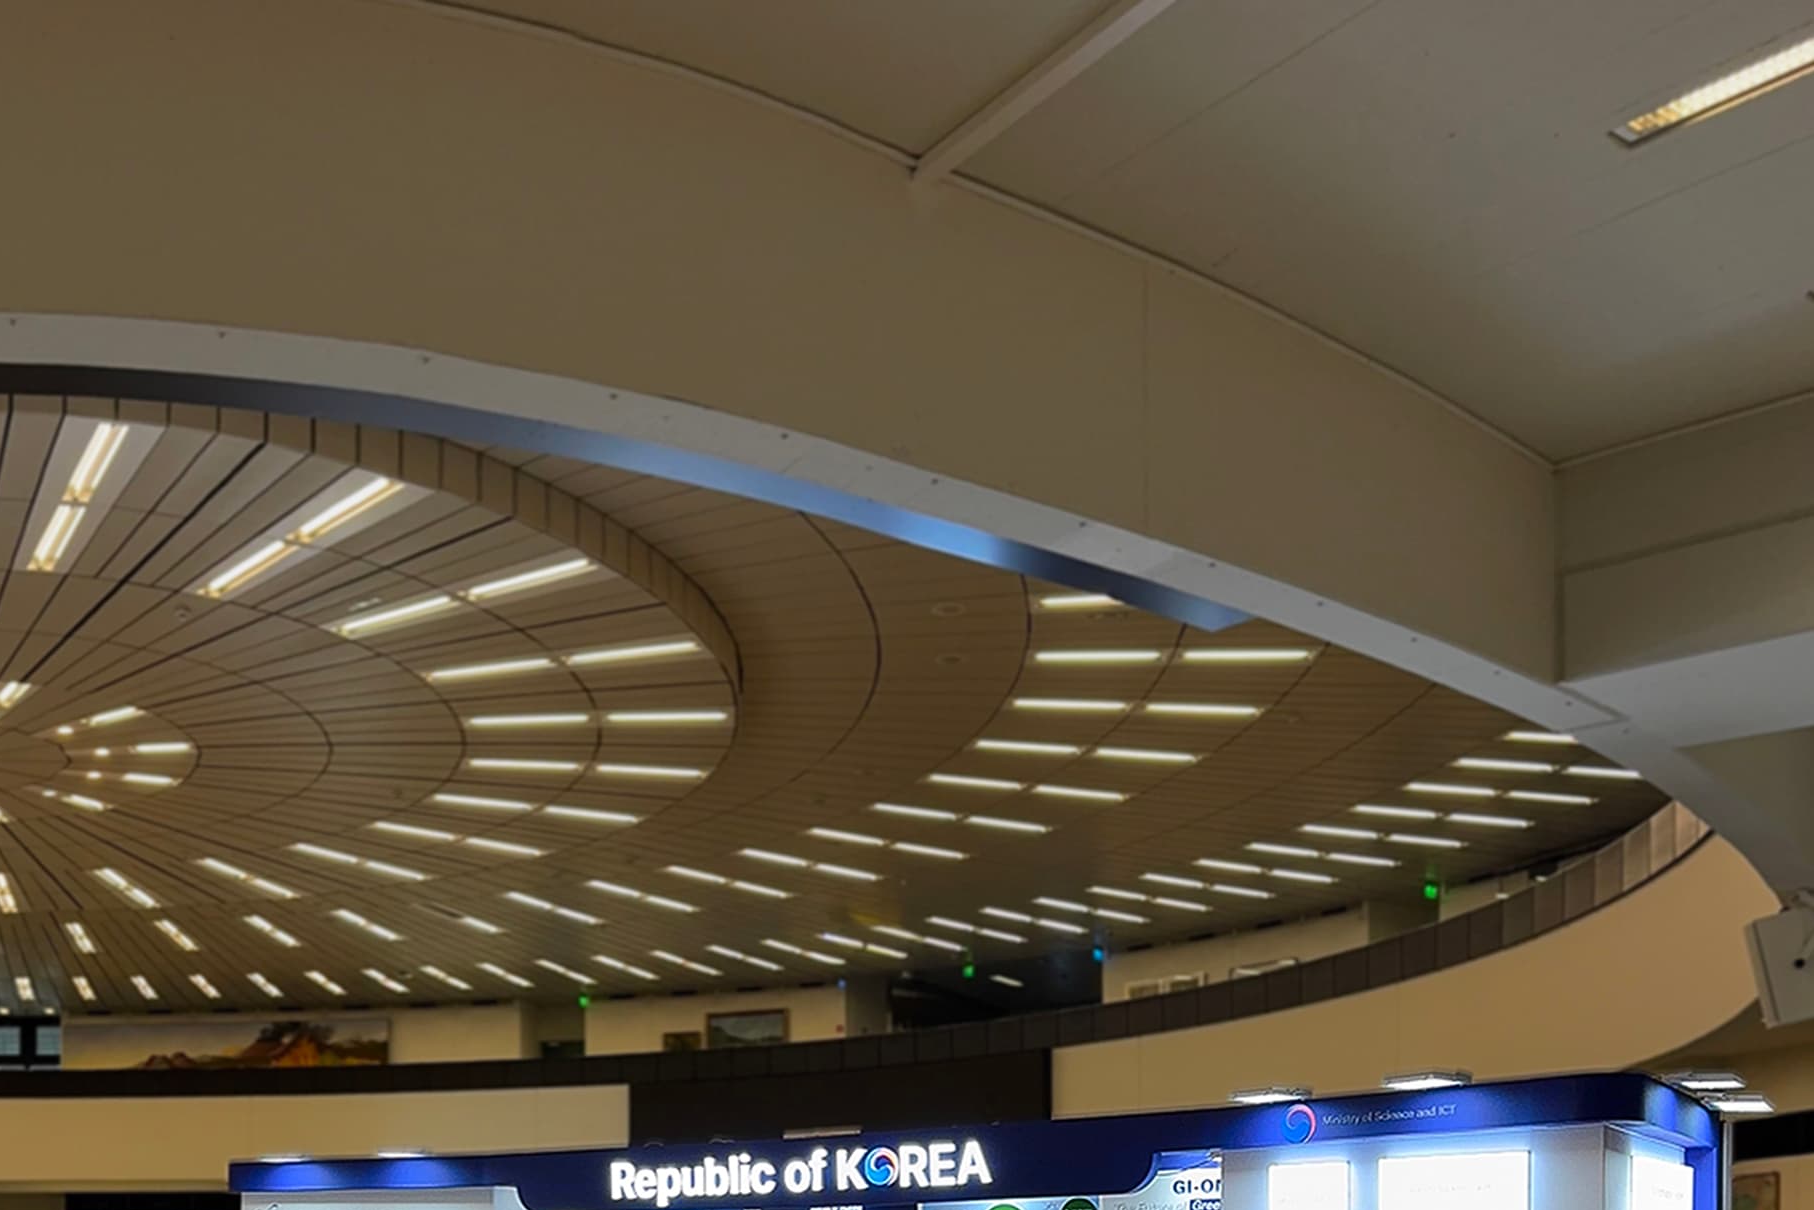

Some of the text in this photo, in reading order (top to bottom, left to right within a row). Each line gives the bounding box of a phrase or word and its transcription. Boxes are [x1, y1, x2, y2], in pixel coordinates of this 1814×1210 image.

[1322, 1103, 1457, 1127] Ministry of Science and ICT
[610, 1141, 993, 1207] Republic of KOREA
